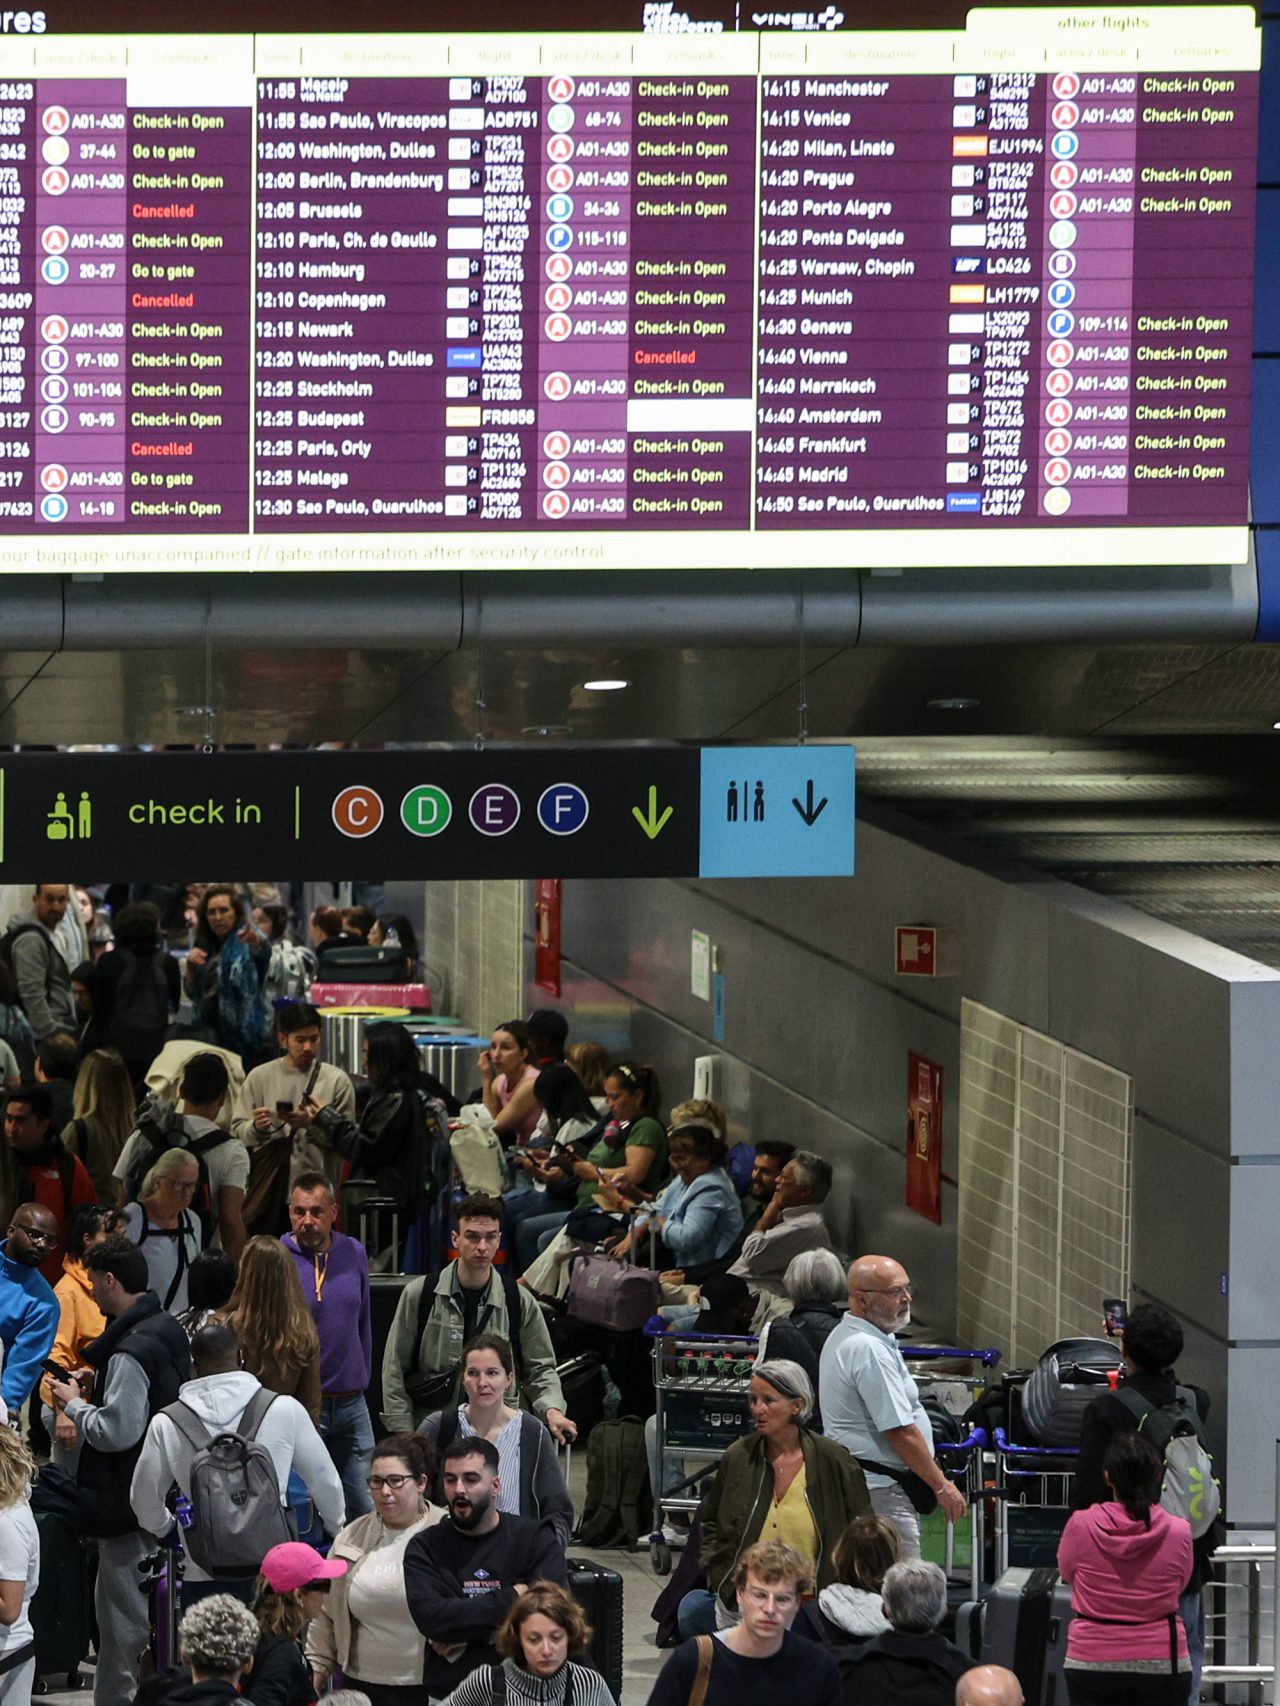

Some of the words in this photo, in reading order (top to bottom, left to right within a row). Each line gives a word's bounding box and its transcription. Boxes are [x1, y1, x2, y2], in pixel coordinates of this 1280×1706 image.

[1058, 16, 1096, 29] other
[1103, 16, 1149, 32] flights
[805, 80, 889, 96] Manchester
[133, 114, 189, 128] Check-in
[192, 114, 224, 131] Open
[804, 110, 850, 126] Venice
[299, 142, 386, 162] Washington,
[390, 142, 435, 158] Dulles
[638, 142, 693, 156] Check-in
[696, 141, 728, 159] Open
[804, 140, 846, 157] Milan,
[851, 140, 894, 156] Linate
[300, 172, 346, 190] Berlin,
[351, 172, 443, 192] Brandenburg
[133, 204, 194, 217] Cancelled
[803, 199, 841, 215] Porto
[844, 199, 891, 219] Alegre
[299, 262, 364, 281] Hamburg
[801, 259, 861, 276] Warsaw,
[865, 259, 914, 277] Chopin
[298, 292, 385, 311] Copenhagen
[635, 351, 695, 364] Cancelled
[800, 349, 847, 364] Vienna
[298, 381, 372, 396] Stockholm
[800, 378, 876, 393] Marrakech
[1136, 376, 1192, 390] Check-in
[1195, 376, 1226, 392] Open
[298, 411, 364, 429] Budapest
[298, 440, 338, 457] Paris,
[342, 440, 371, 458] Orly
[799, 437, 866, 453] Frankfurt
[799, 467, 847, 482] Madrid
[297, 500, 322, 514] Sao
[326, 499, 369, 515] Paulo,
[372, 499, 443, 513] Guarulhos
[37, 548, 109, 567] baggage
[115, 547, 251, 566] unaccompanied
[275, 549, 311, 566] gate
[318, 547, 418, 561] information
[424, 547, 462, 561] after
[470, 547, 538, 564] security
[544, 546, 605, 560] control
[129, 799, 224, 824] check
[236, 799, 260, 823] in
[348, 797, 368, 826] C
[417, 796, 438, 825] D
[485, 796, 504, 825] E
[555, 795, 573, 824] F
